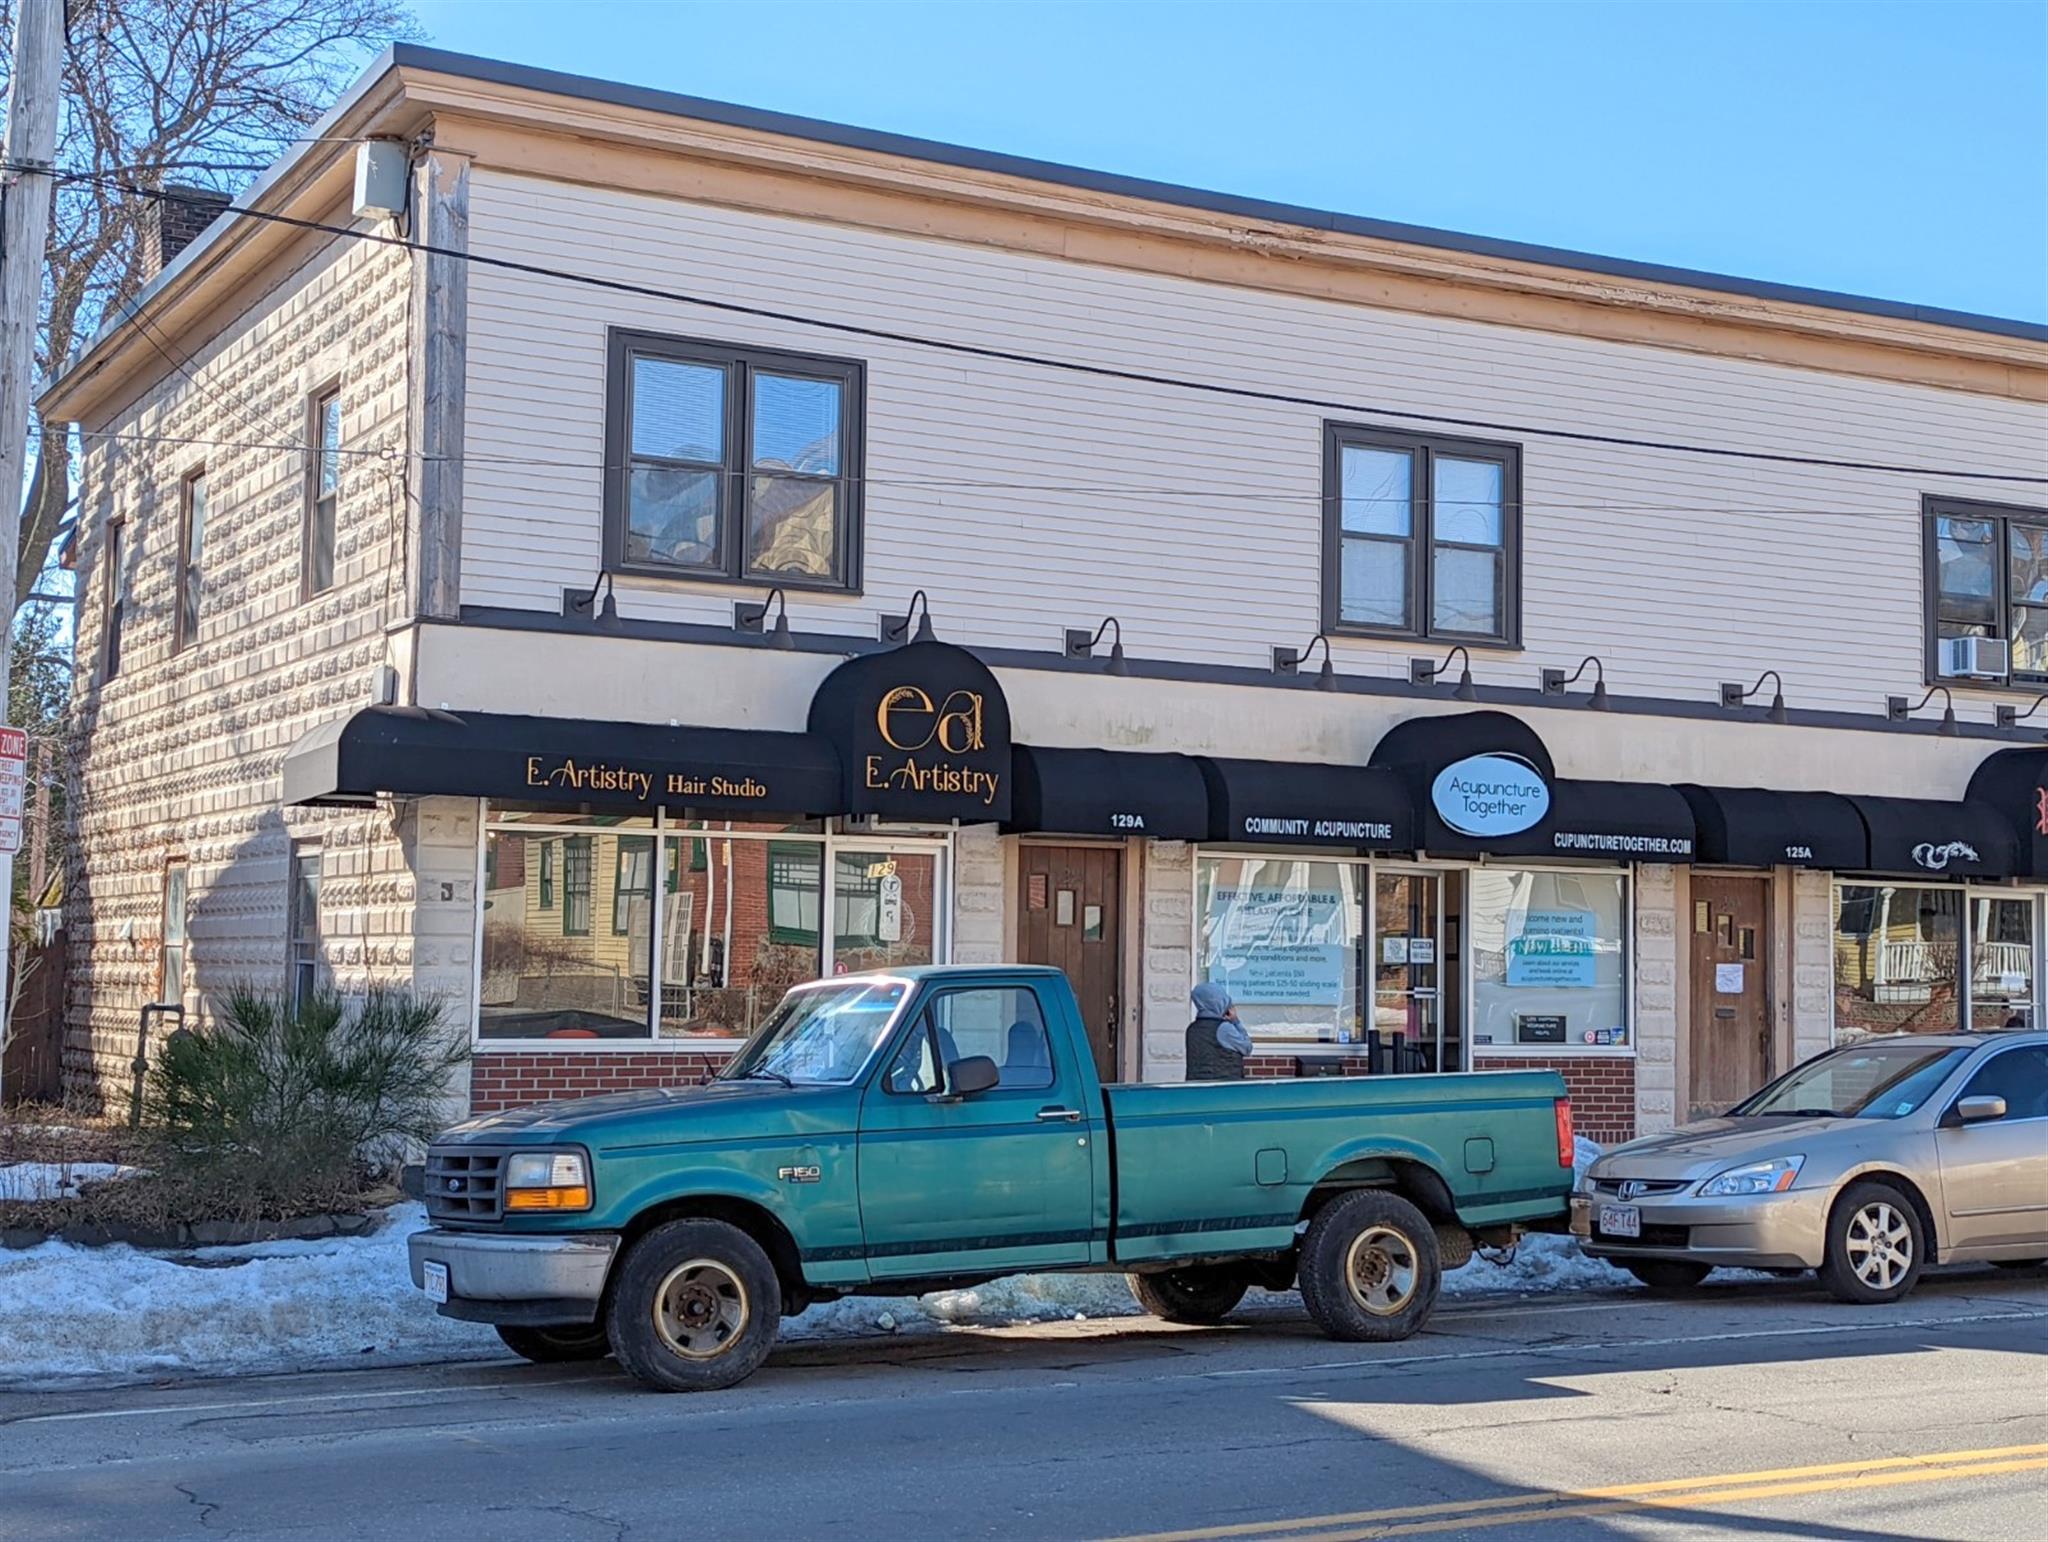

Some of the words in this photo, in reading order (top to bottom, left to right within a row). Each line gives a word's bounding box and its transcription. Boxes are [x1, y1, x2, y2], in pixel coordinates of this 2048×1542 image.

[1, 733, 25, 757] ZONE
[550, 758, 653, 800] Artistry
[667, 774, 706, 795] Hair
[711, 776, 767, 798] Studio
[890, 758, 1000, 805] Artistry
[1449, 776, 1541, 799] Acupuncture
[1462, 796, 1527, 819] Together
[1111, 814, 1144, 829] 129A
[1245, 817, 1309, 836] COMMUNITY
[1314, 820, 1392, 839] ACUPUNCTURE
[1785, 846, 1812, 859] 125A
[870, 862, 895, 876] 129
[778, 1166, 820, 1179] F150
